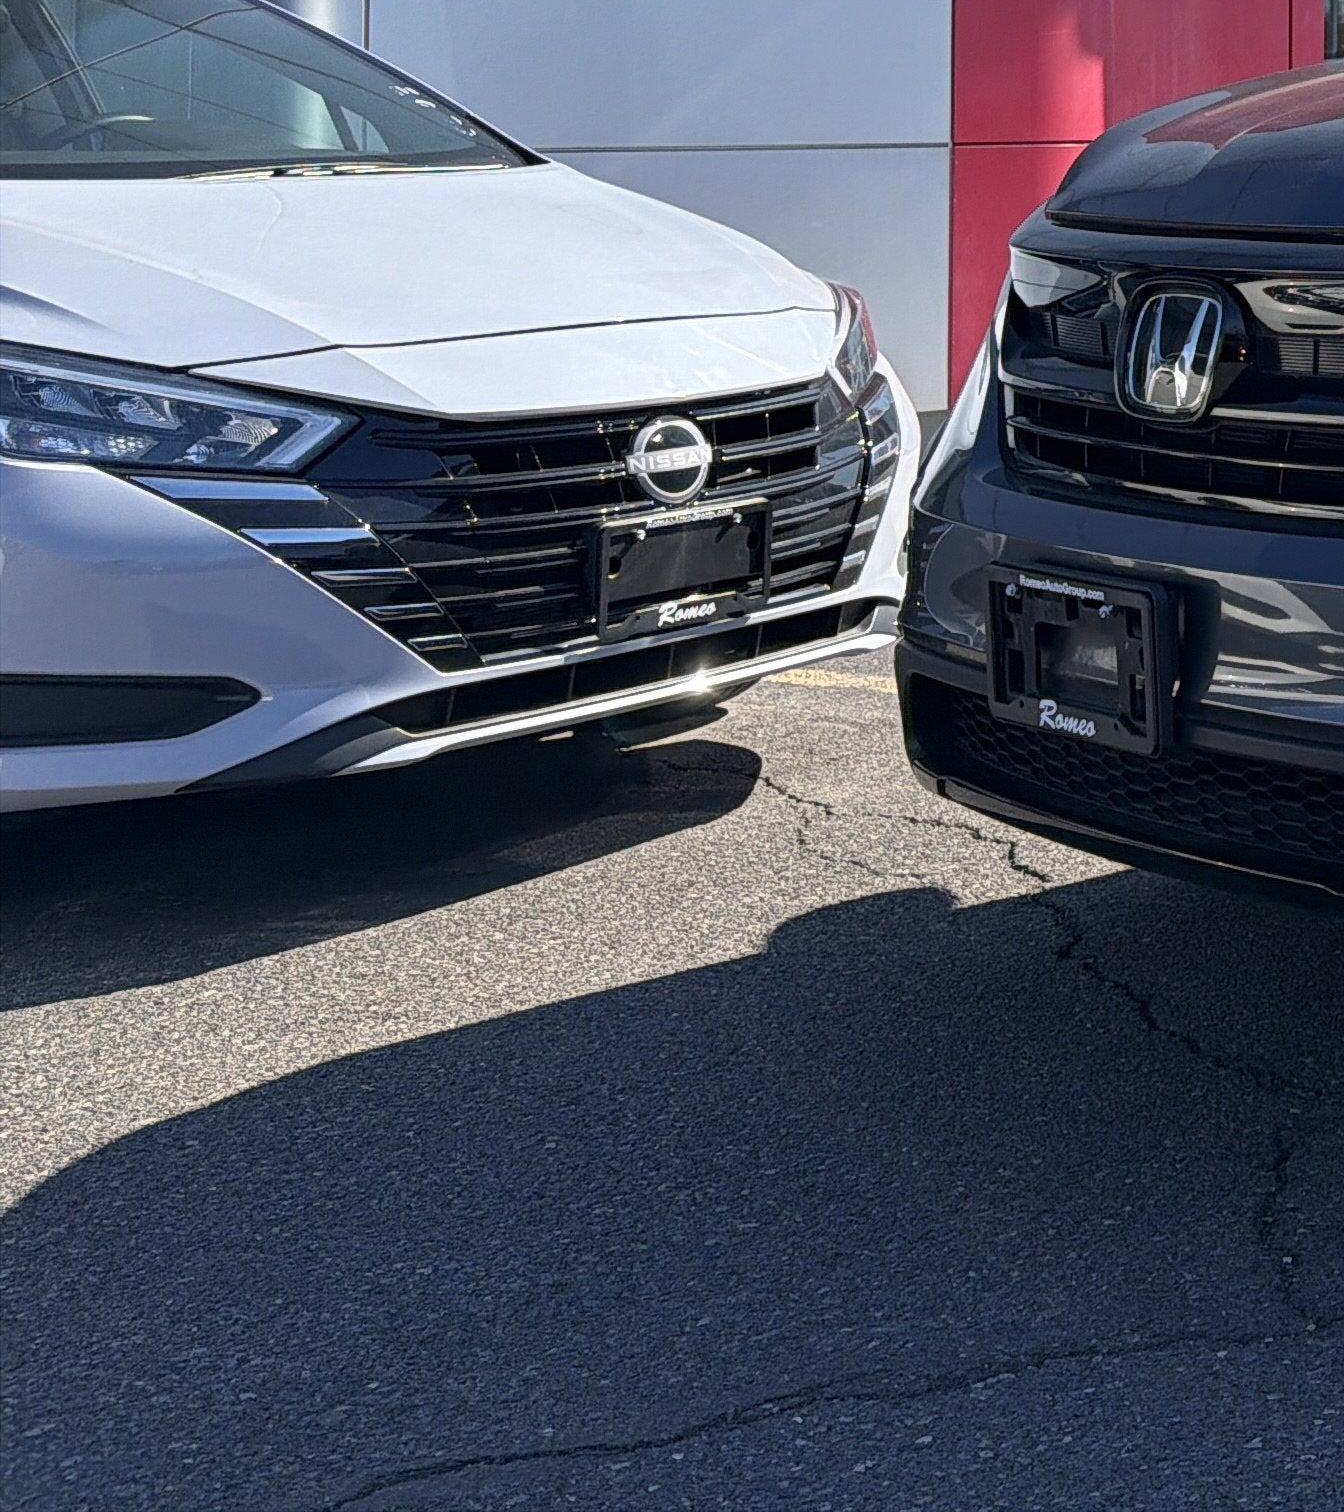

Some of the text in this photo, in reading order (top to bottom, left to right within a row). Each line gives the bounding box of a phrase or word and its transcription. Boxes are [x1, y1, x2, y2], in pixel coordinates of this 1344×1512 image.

[629, 447, 712, 472] NISSAN
[1019, 574, 1105, 601] RomeoAutoGroup.com
[658, 601, 717, 628] Romeo
[1039, 699, 1097, 737] Romeo
